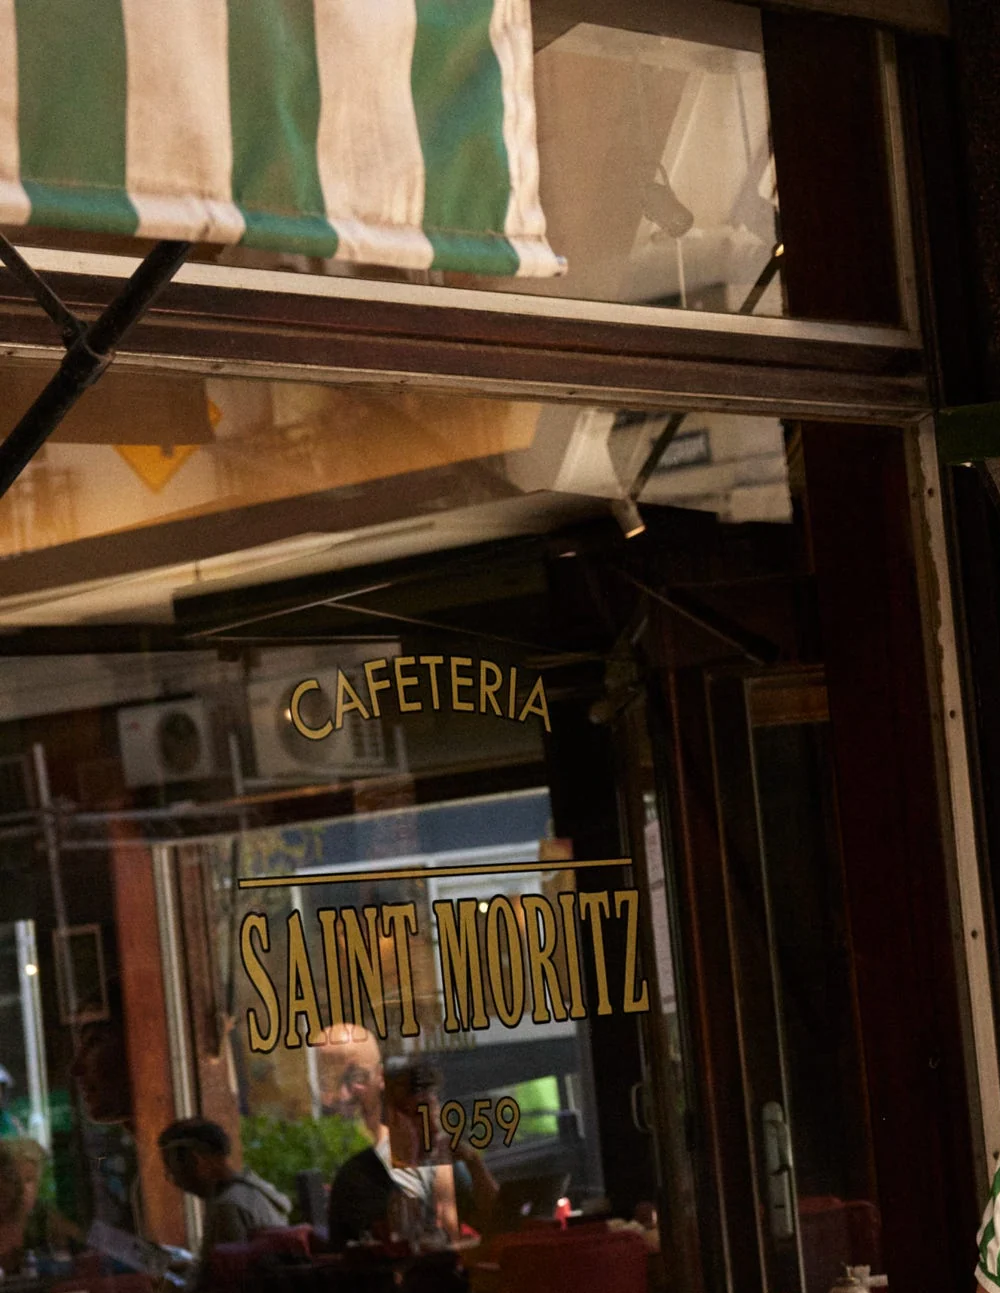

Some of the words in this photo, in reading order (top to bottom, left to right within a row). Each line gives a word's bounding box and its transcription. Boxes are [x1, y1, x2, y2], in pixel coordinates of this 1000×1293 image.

[289, 655, 552, 741] CAFETERIA
[238, 902, 420, 1055] SAINT
[432, 888, 651, 1034] MORITZ
[415, 1095, 522, 1154] 1959
